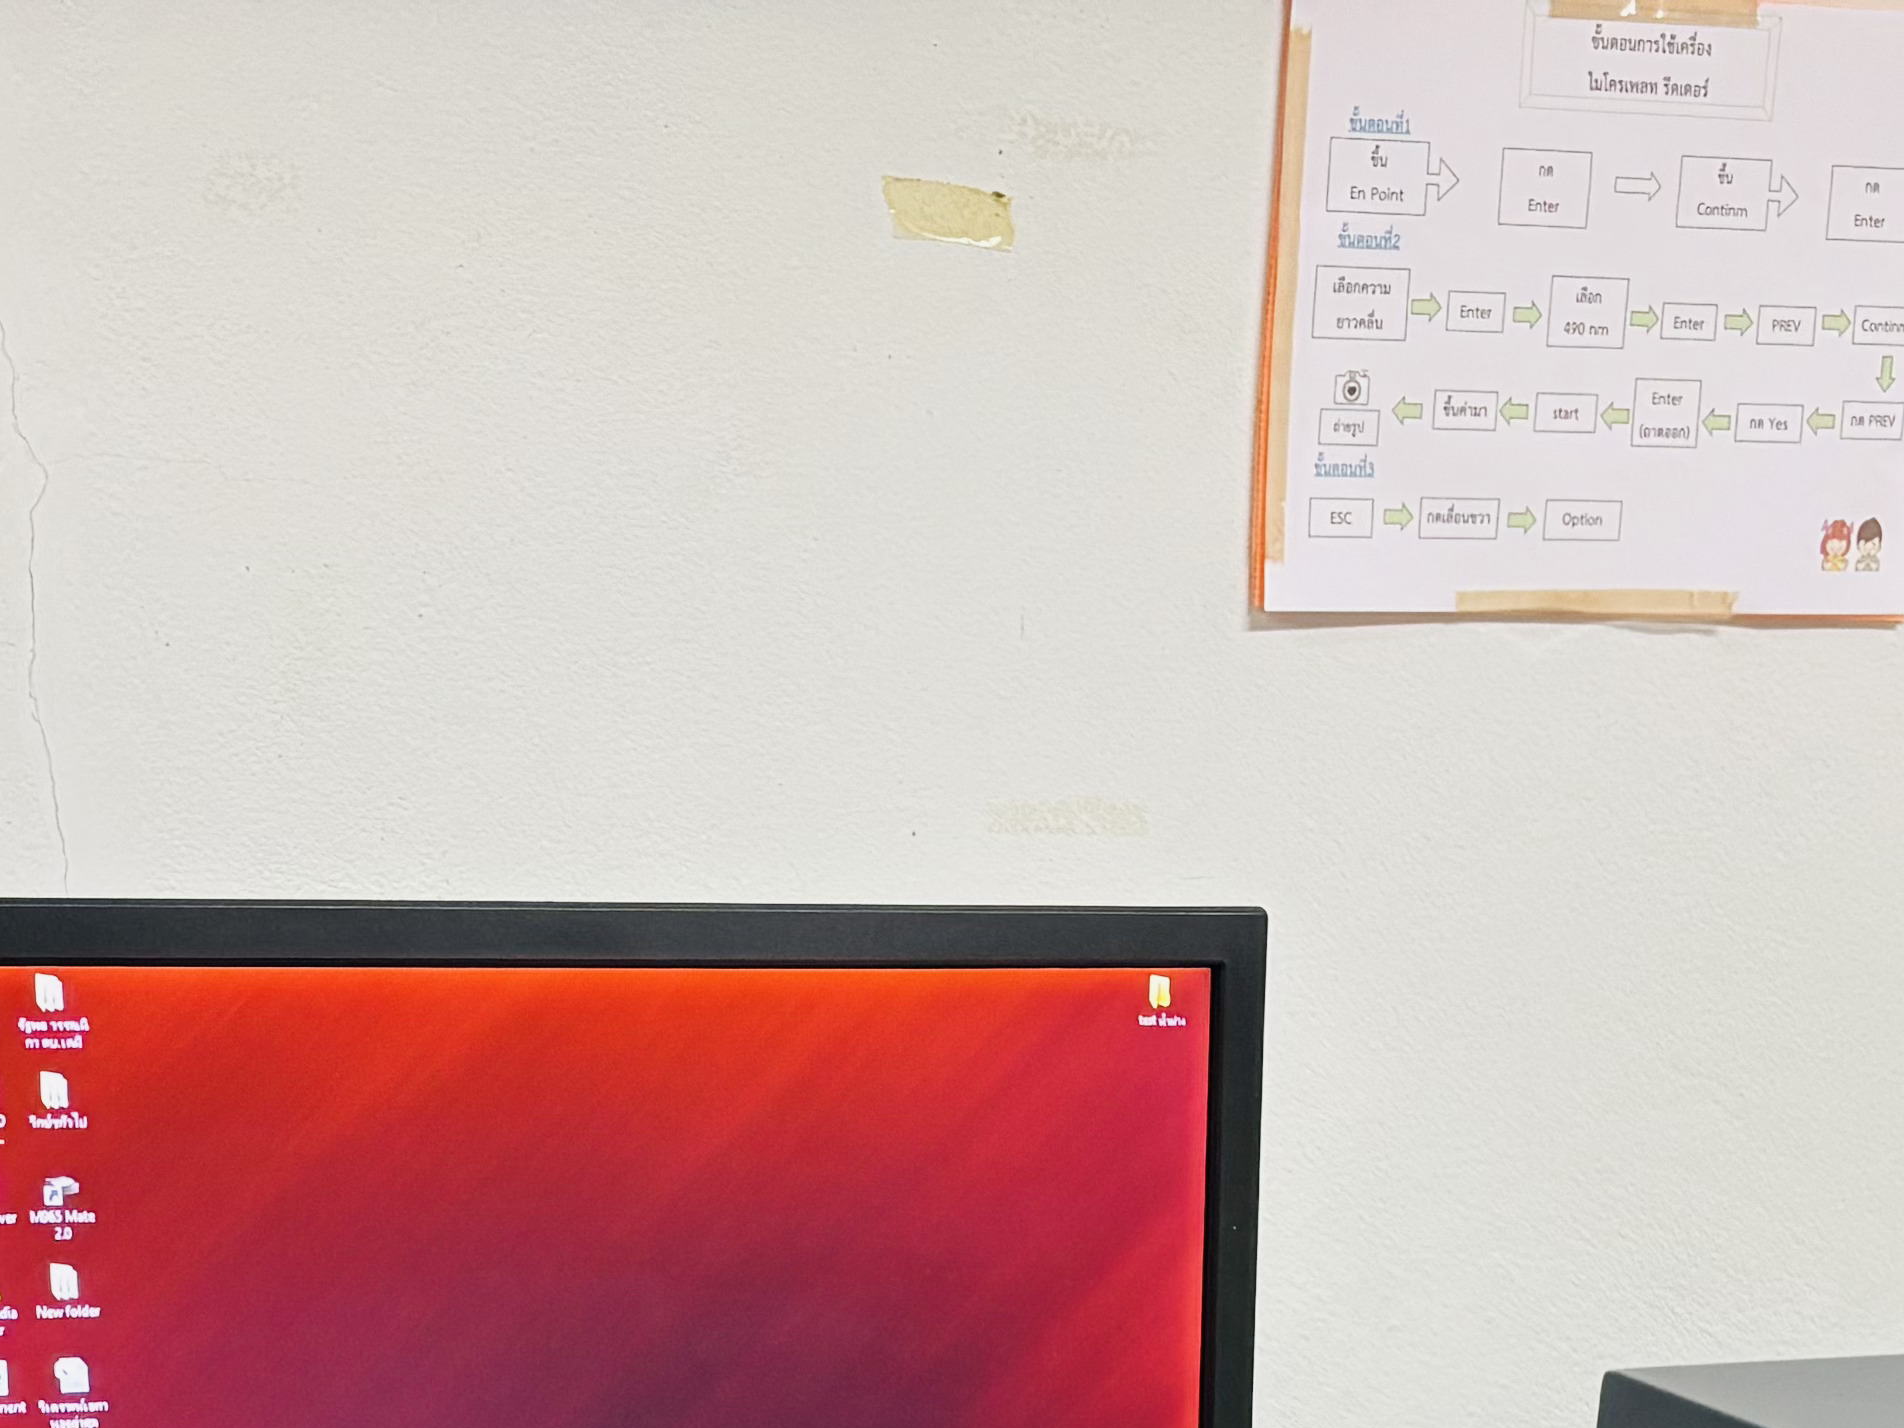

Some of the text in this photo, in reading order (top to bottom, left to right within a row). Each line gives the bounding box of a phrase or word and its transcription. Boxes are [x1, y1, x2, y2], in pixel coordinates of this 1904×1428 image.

[1350, 187, 1404, 202] En Point
[1528, 199, 1560, 214] Enter
[1854, 214, 1885, 229] Enter
[1460, 305, 1492, 320] Enter
[1673, 317, 1705, 332] Enter
[1772, 319, 1801, 333] PREV
[1652, 392, 1684, 407] Enter
[1552, 408, 1579, 421] start
[1768, 418, 1788, 431] Yes
[1330, 512, 1353, 526] ESC
[1562, 512, 1603, 530] Option
[36, 1305, 100, 1319] New folder
